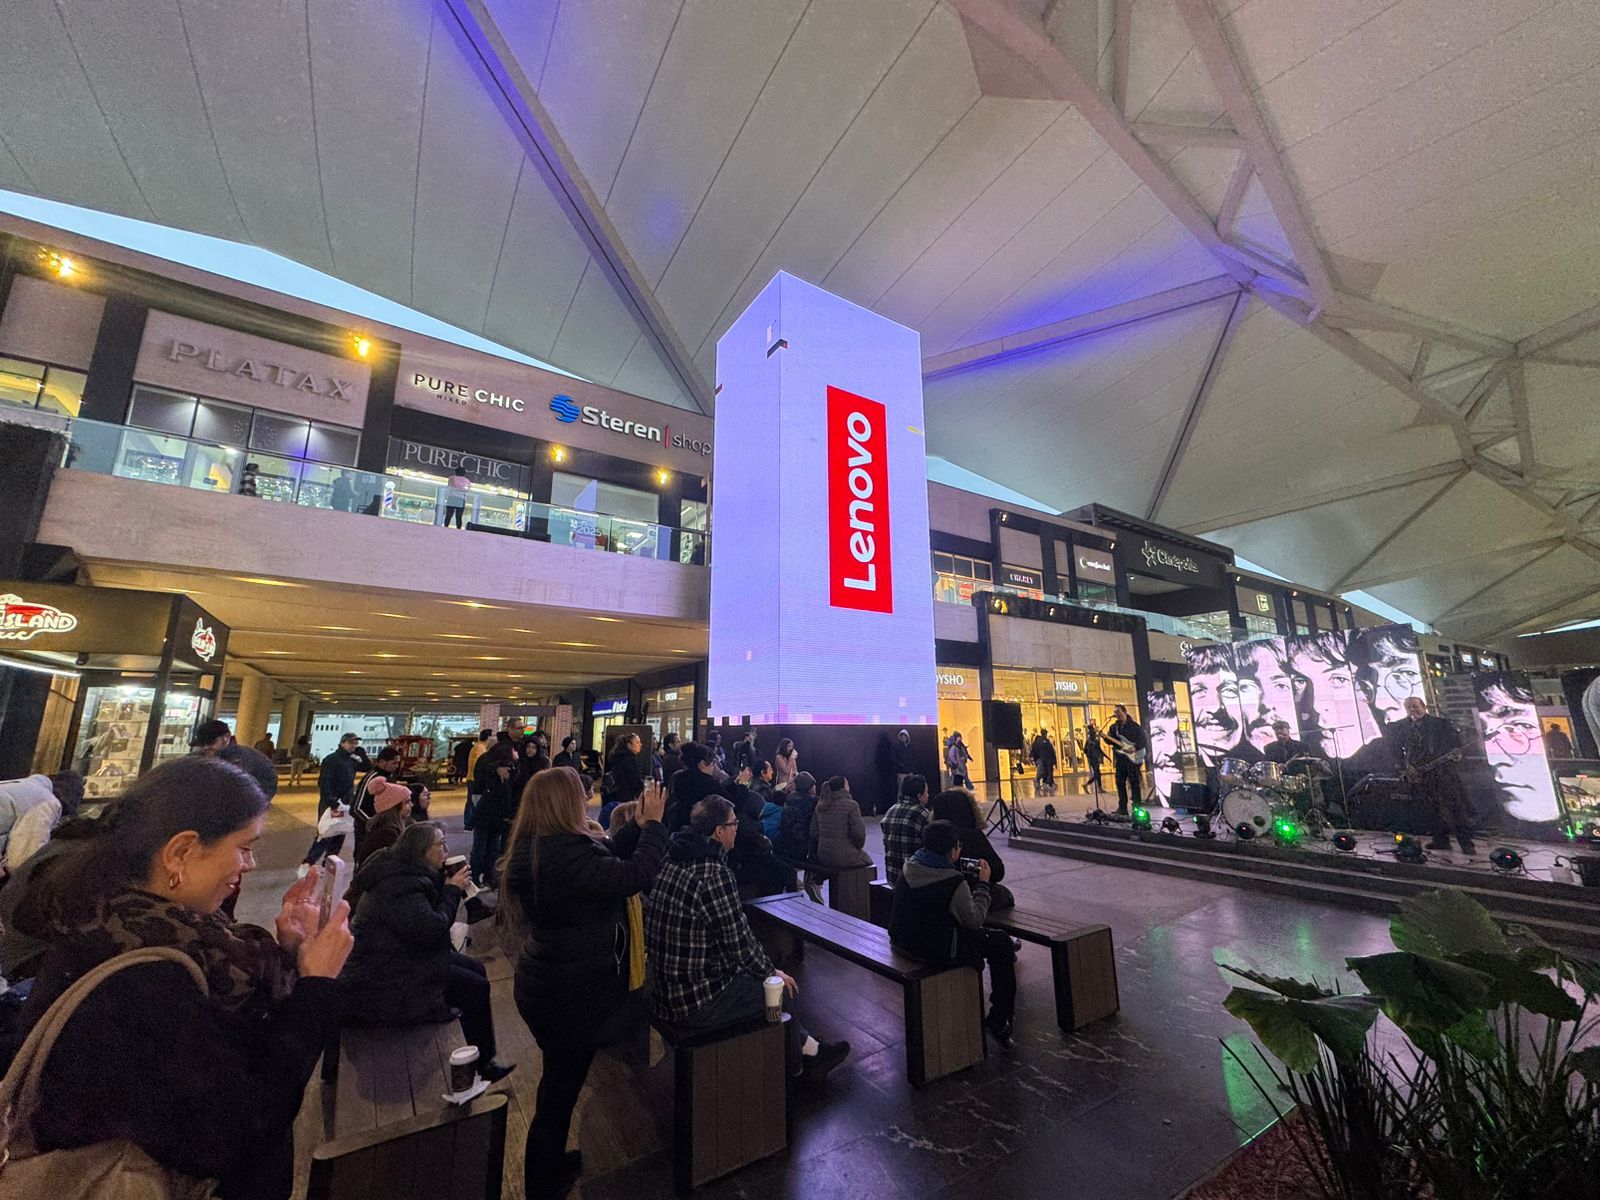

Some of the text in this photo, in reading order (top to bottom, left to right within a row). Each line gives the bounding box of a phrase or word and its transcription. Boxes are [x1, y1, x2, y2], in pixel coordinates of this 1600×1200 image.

[168, 339, 352, 401] PLATAX
[413, 373, 526, 413] PURE CHIC
[436, 394, 467, 406] MIXED
[582, 406, 712, 456] Steren shop
[843, 411, 877, 592] Lenovo
